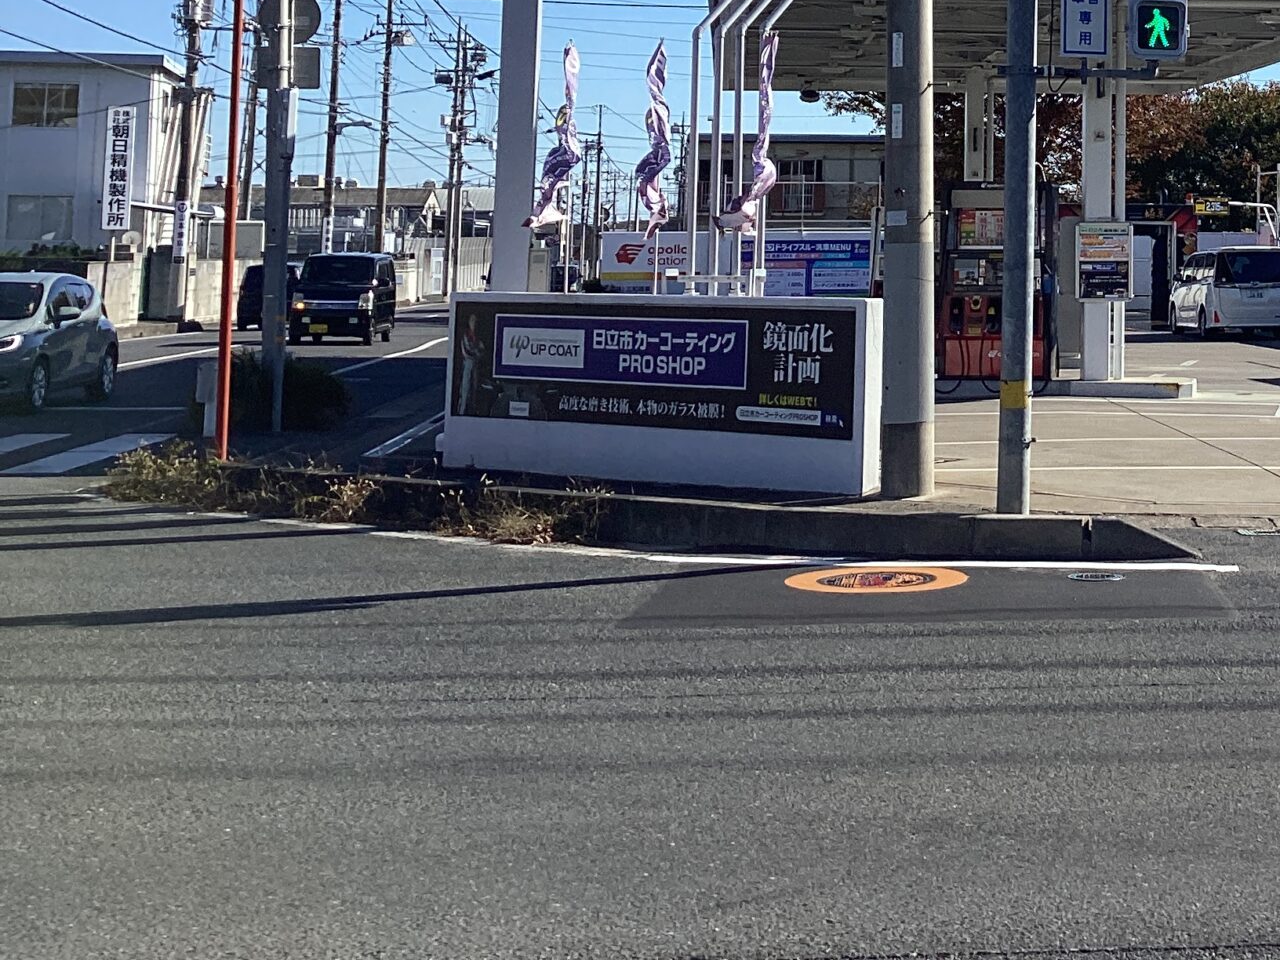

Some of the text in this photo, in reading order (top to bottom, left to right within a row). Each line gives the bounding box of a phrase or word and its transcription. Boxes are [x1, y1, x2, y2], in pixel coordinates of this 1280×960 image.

[106, 124, 130, 227] 朝日精機製作所
[647, 256, 687, 265] sation
[593, 329, 736, 354] 日立市カーコーティング
[763, 320, 834, 354] 鏡面化
[530, 343, 547, 356] UP
[548, 343, 580, 358] COAT
[618, 353, 707, 376] PRO SHOP
[773, 354, 821, 385] 計画
